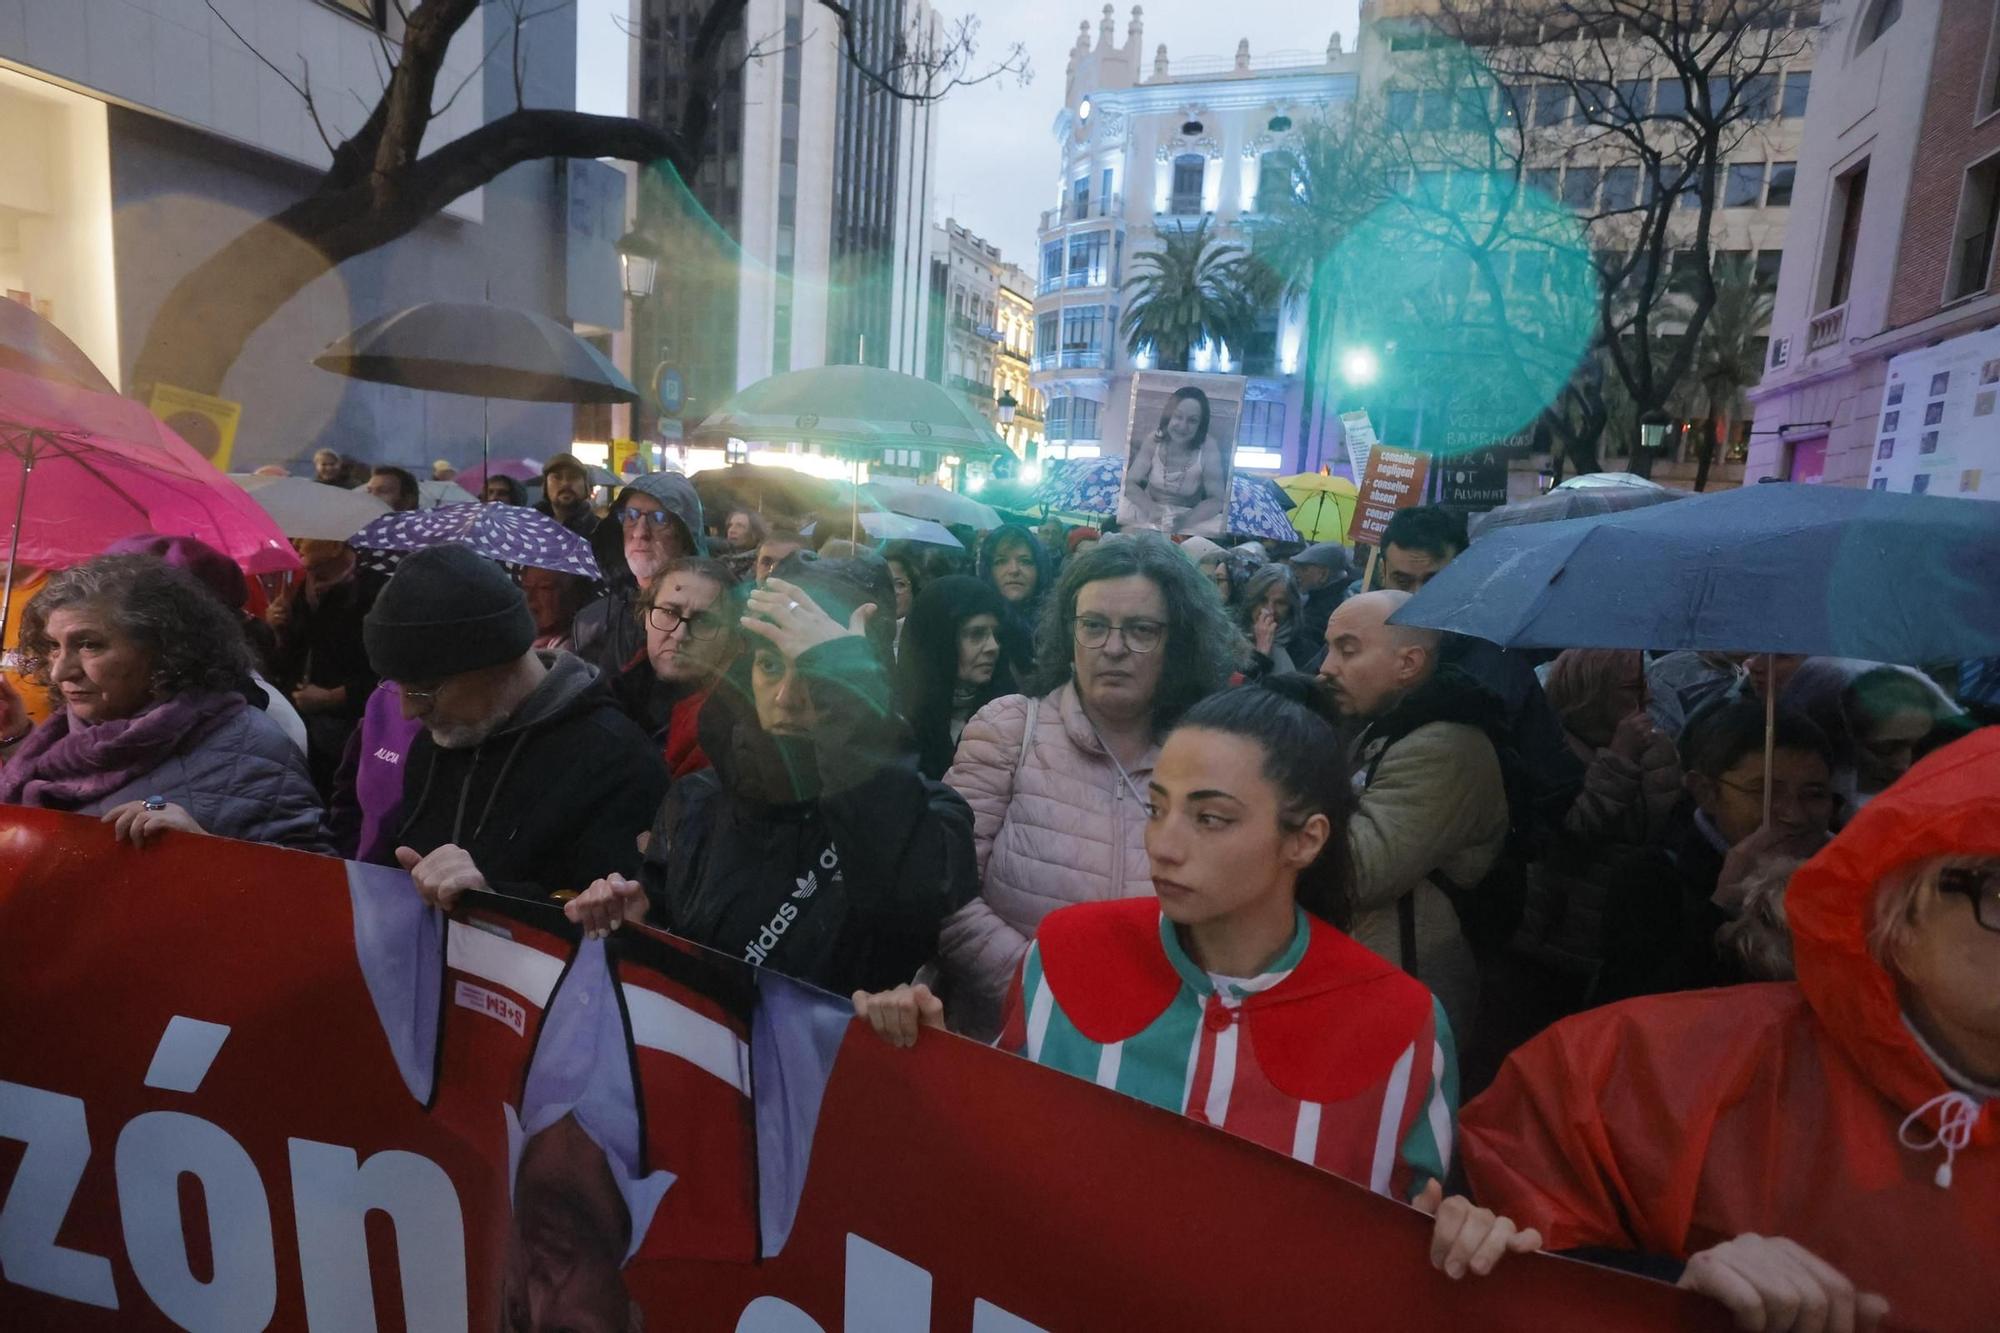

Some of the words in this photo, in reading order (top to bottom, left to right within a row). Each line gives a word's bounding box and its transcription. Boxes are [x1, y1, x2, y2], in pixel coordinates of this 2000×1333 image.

[1484, 452, 1495, 465] A
[1377, 463, 1415, 478] negligent
[1445, 470, 1478, 484] TOT
[1373, 479, 1410, 494] conseller
[1369, 490, 1398, 504] absent
[1362, 518, 1372, 530] al
